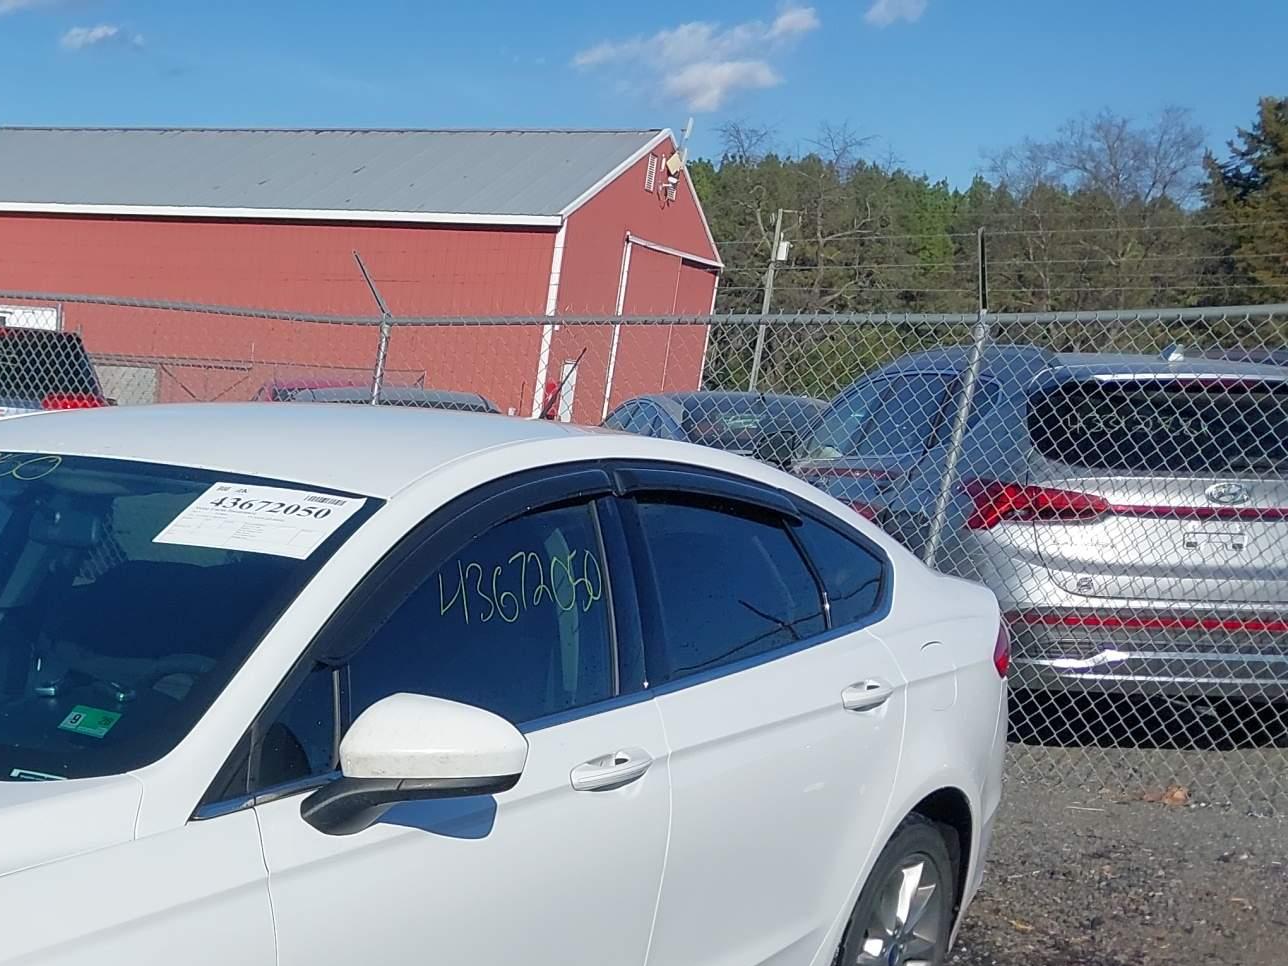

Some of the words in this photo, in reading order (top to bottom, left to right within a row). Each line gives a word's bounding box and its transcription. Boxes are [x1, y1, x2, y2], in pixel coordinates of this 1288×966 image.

[210, 496, 332, 519] 43672050
[438, 549, 602, 625] 43672050
[70, 714, 82, 724] 9
